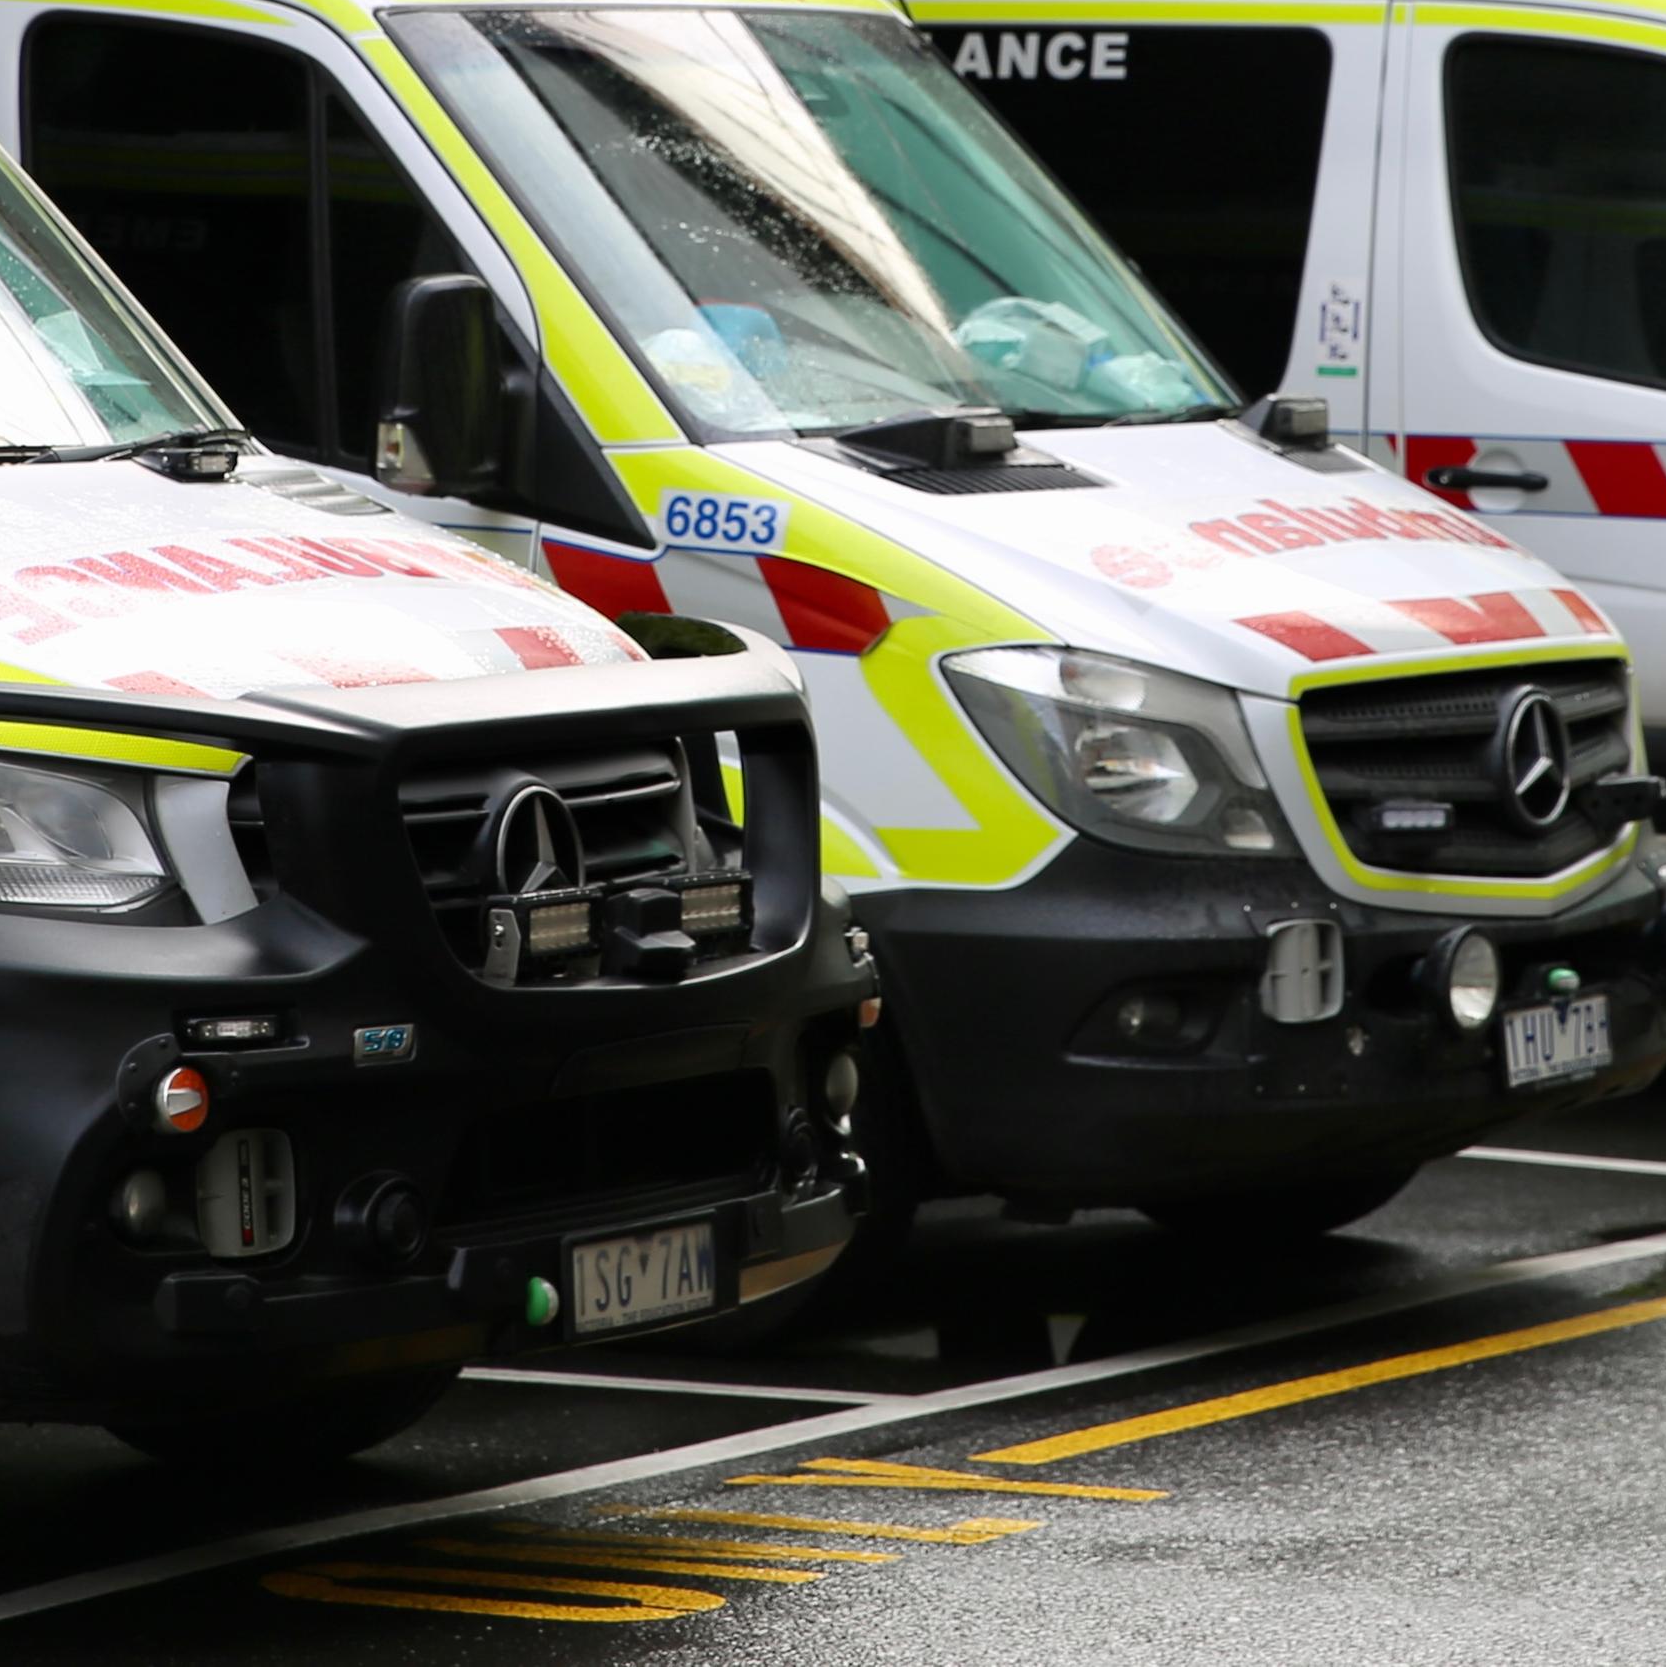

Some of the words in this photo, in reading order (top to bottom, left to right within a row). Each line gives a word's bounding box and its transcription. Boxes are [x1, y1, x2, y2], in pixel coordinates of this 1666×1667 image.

[923, 31, 1129, 80] ANCE
[667, 495, 777, 544] 6853
[576, 1245, 633, 1316] 1SG
